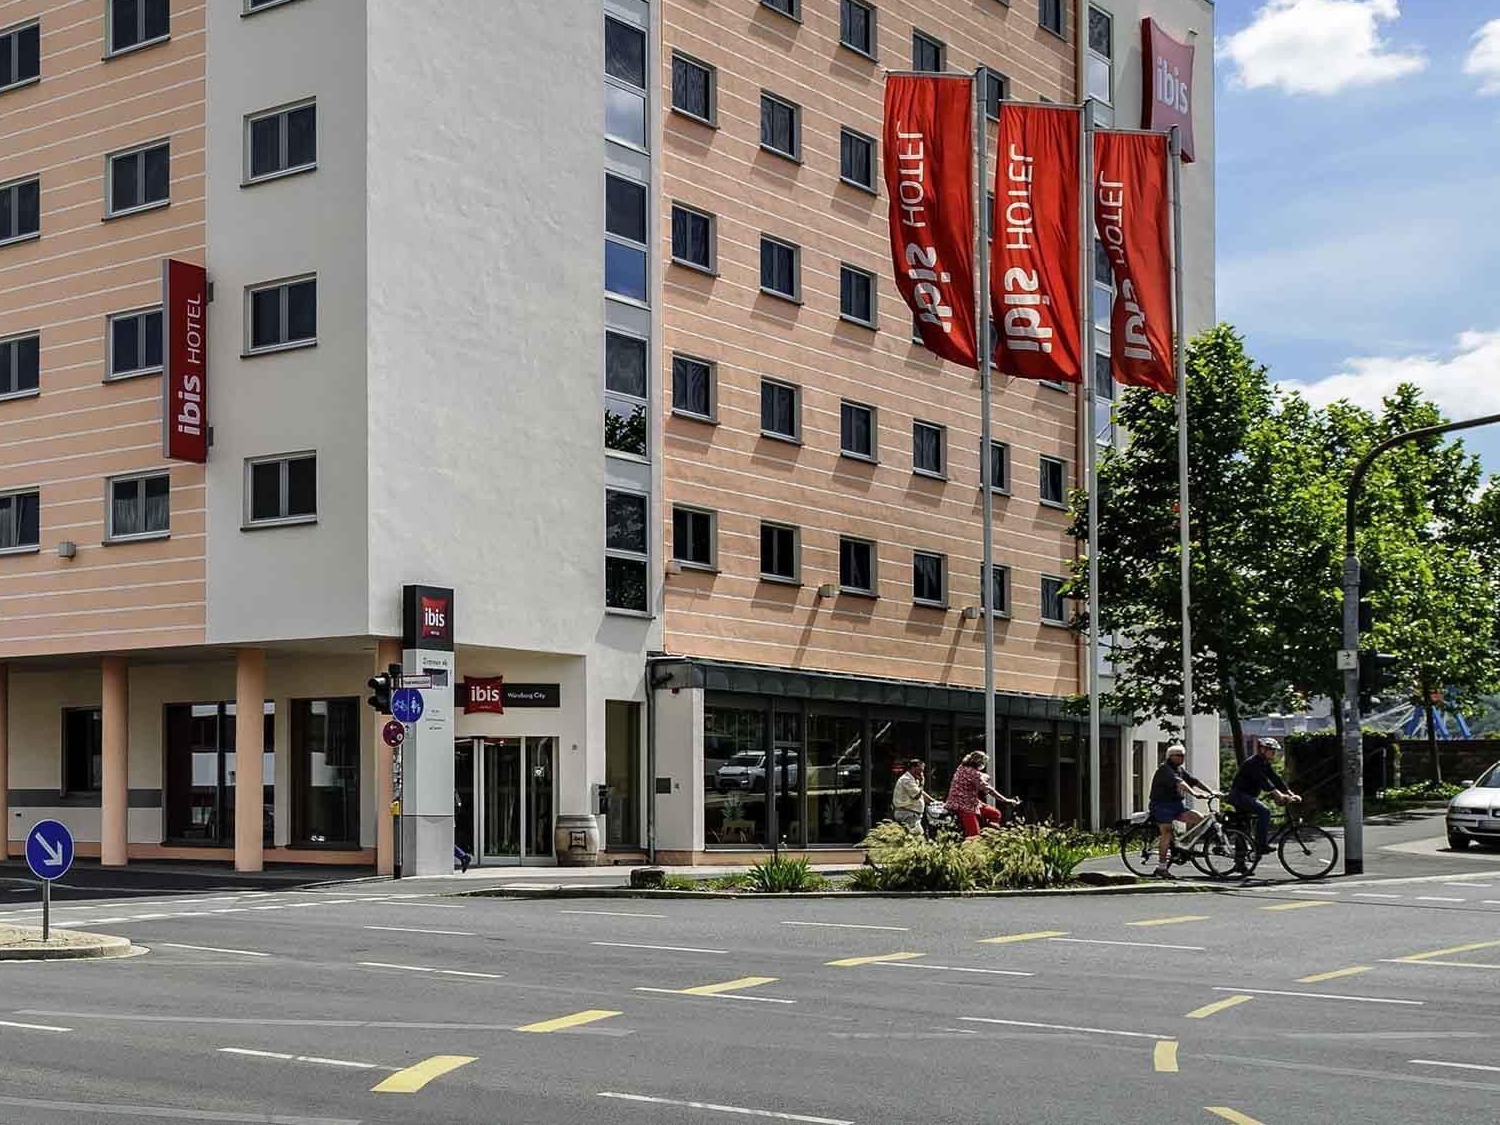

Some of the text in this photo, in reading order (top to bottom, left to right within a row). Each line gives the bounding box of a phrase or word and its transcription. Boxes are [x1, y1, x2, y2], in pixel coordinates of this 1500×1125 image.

[1156, 56, 1188, 115] ibis
[178, 292, 202, 436] ibis HOTEL
[424, 607, 445, 628] ibis
[470, 685, 500, 702] ibis
